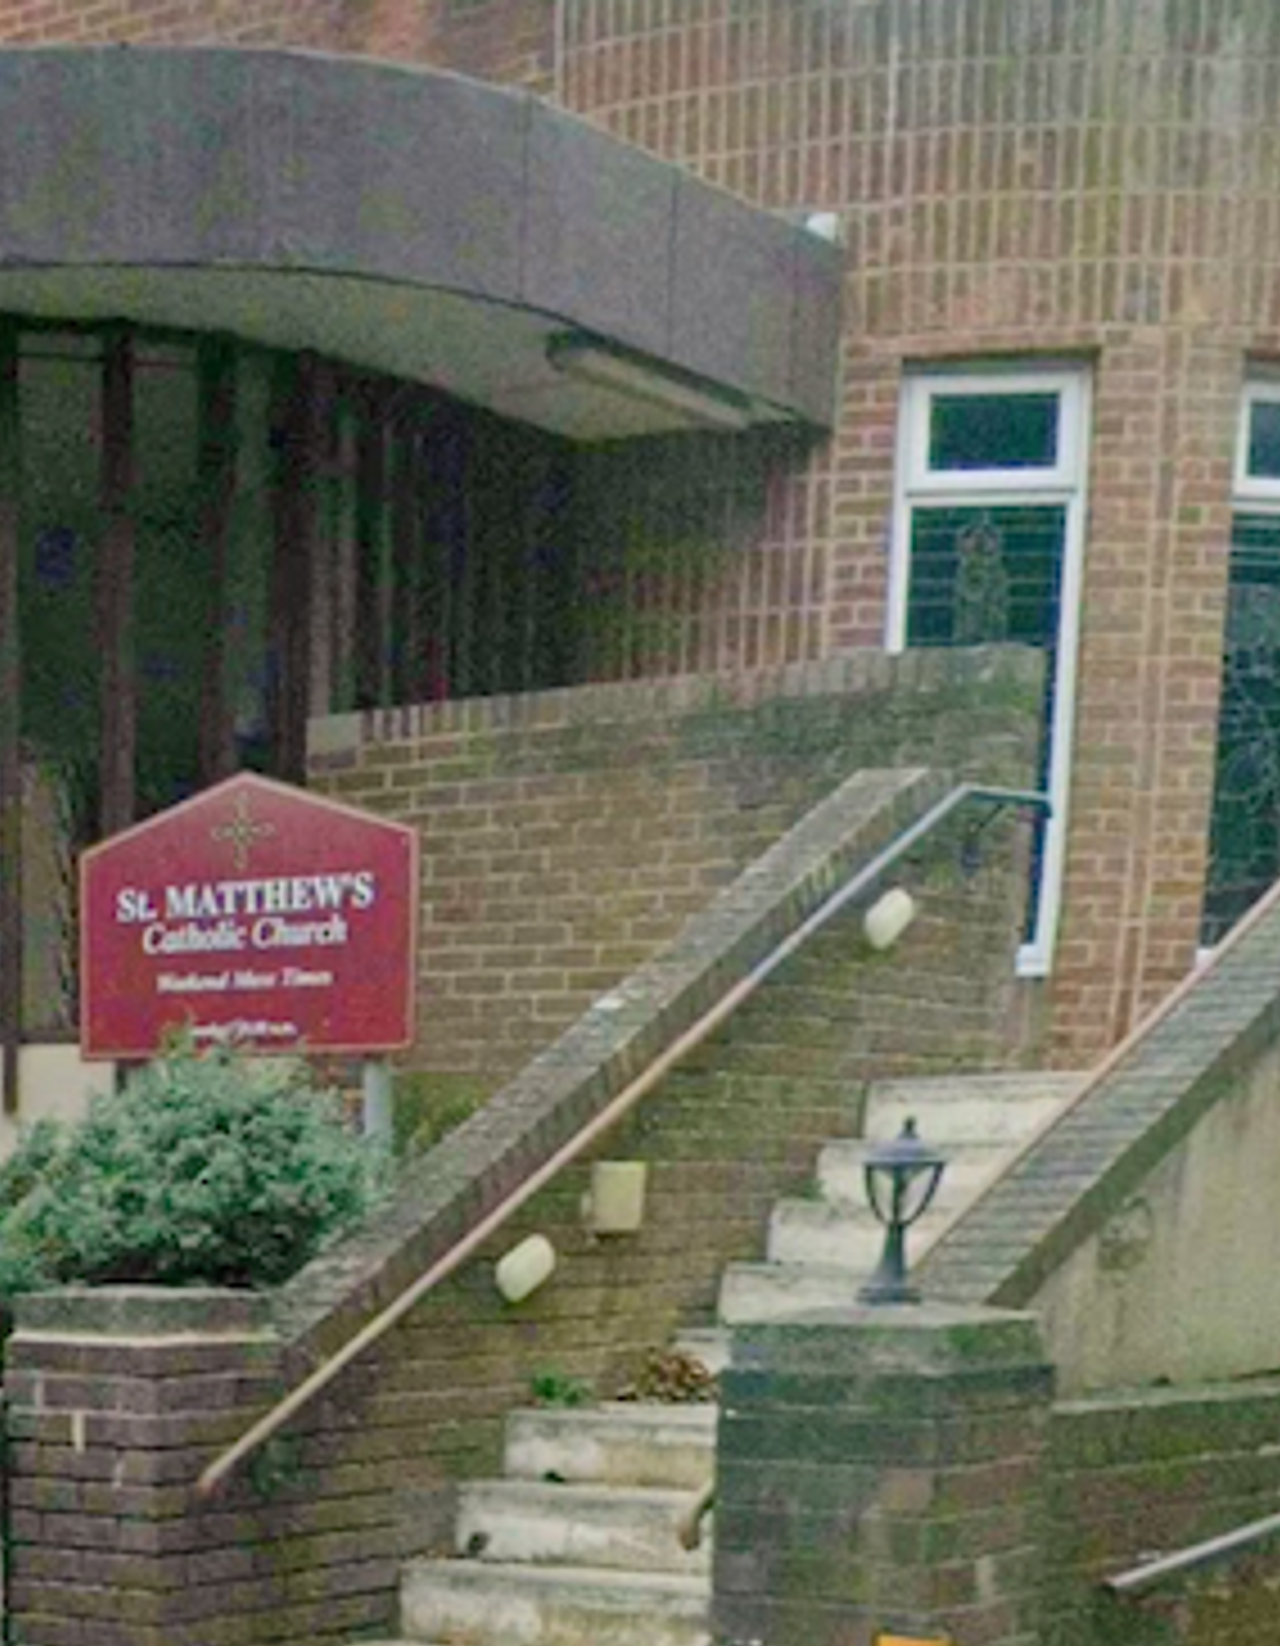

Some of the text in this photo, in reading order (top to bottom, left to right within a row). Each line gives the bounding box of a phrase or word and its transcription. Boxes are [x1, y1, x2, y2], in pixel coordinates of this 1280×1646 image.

[166, 872, 373, 917] MATTHEW'S
[143, 914, 347, 954] Catholic Church
